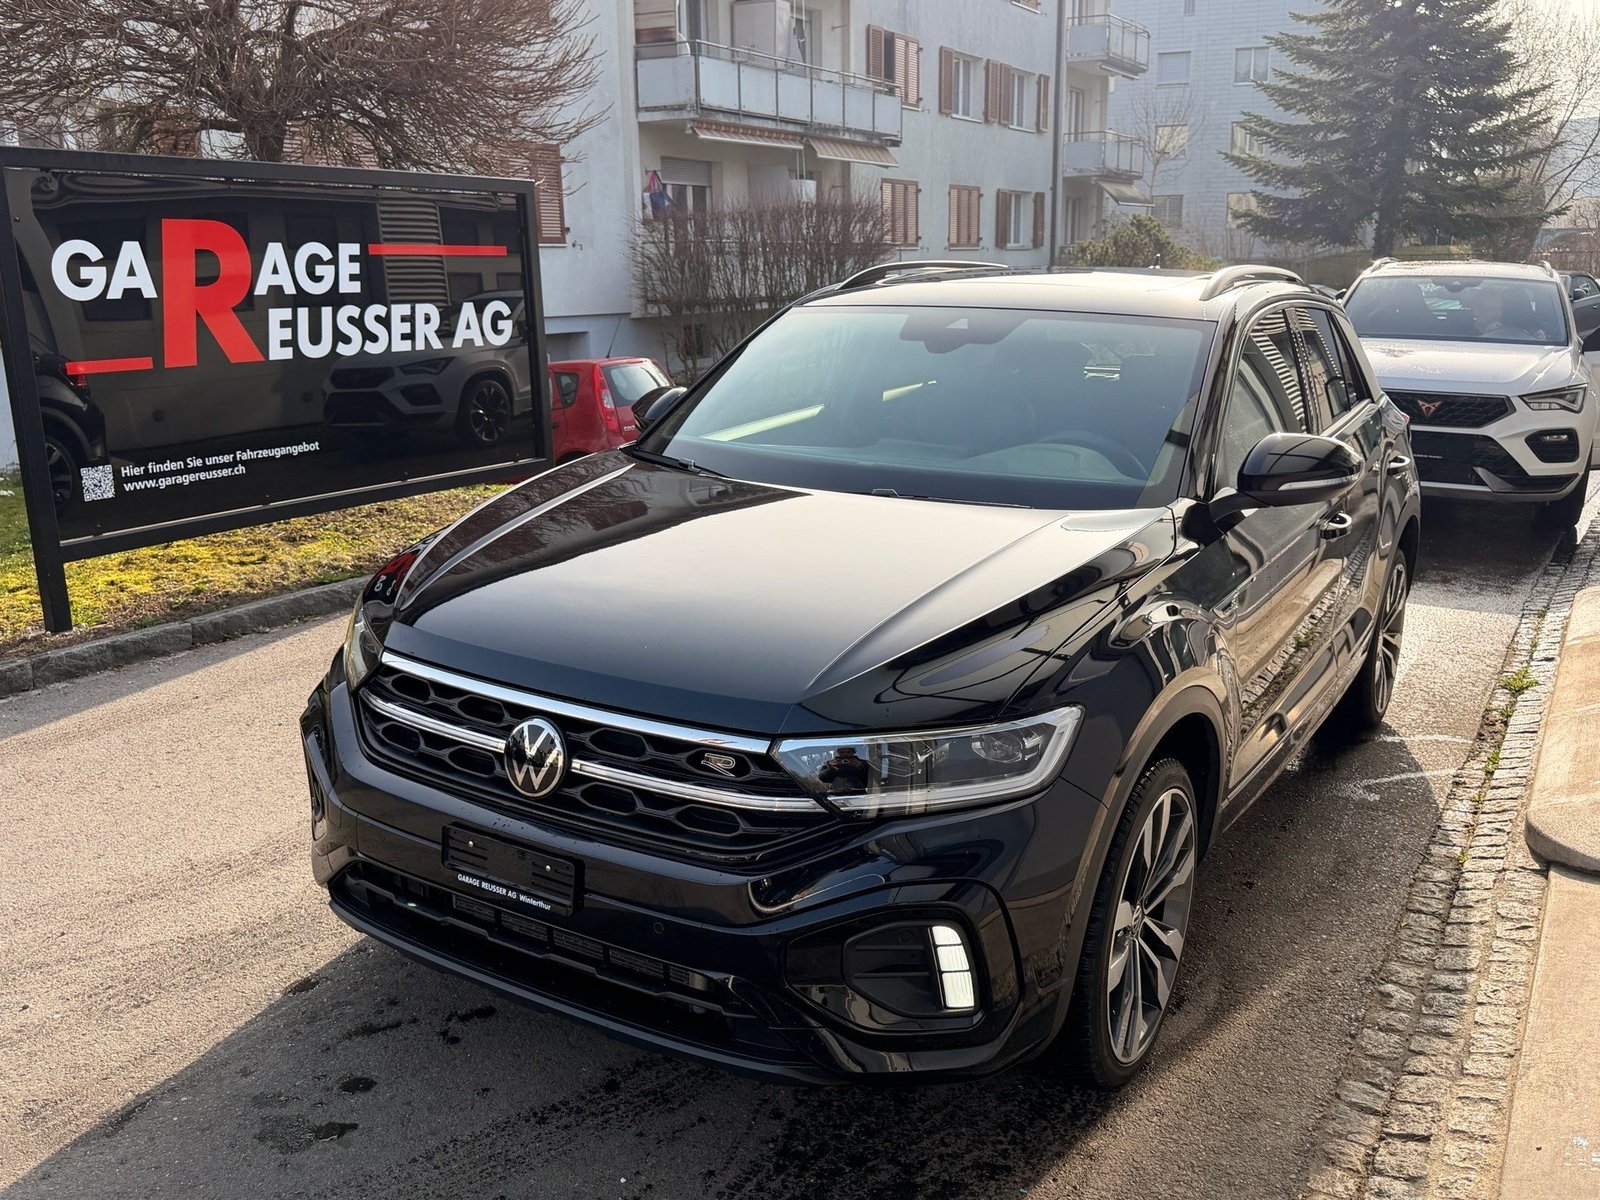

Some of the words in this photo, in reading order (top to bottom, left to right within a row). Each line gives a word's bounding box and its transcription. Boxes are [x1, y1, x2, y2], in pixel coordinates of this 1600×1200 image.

[51, 218, 361, 369] GARAGE
[452, 300, 513, 348] AG
[121, 466, 145, 477] Hier
[147, 460, 184, 475] finden
[186, 456, 203, 468] Sie
[205, 453, 235, 466] unser
[236, 441, 320, 461] Fahrzeugangebot
[123, 464, 246, 492] www.garagereusser.ch
[505, 717, 564, 797] VW
[457, 874, 480, 886] GARAGE
[481, 882, 507, 895] REUSSER
[507, 890, 517, 899] AG
[519, 894, 552, 910] Winterthur
